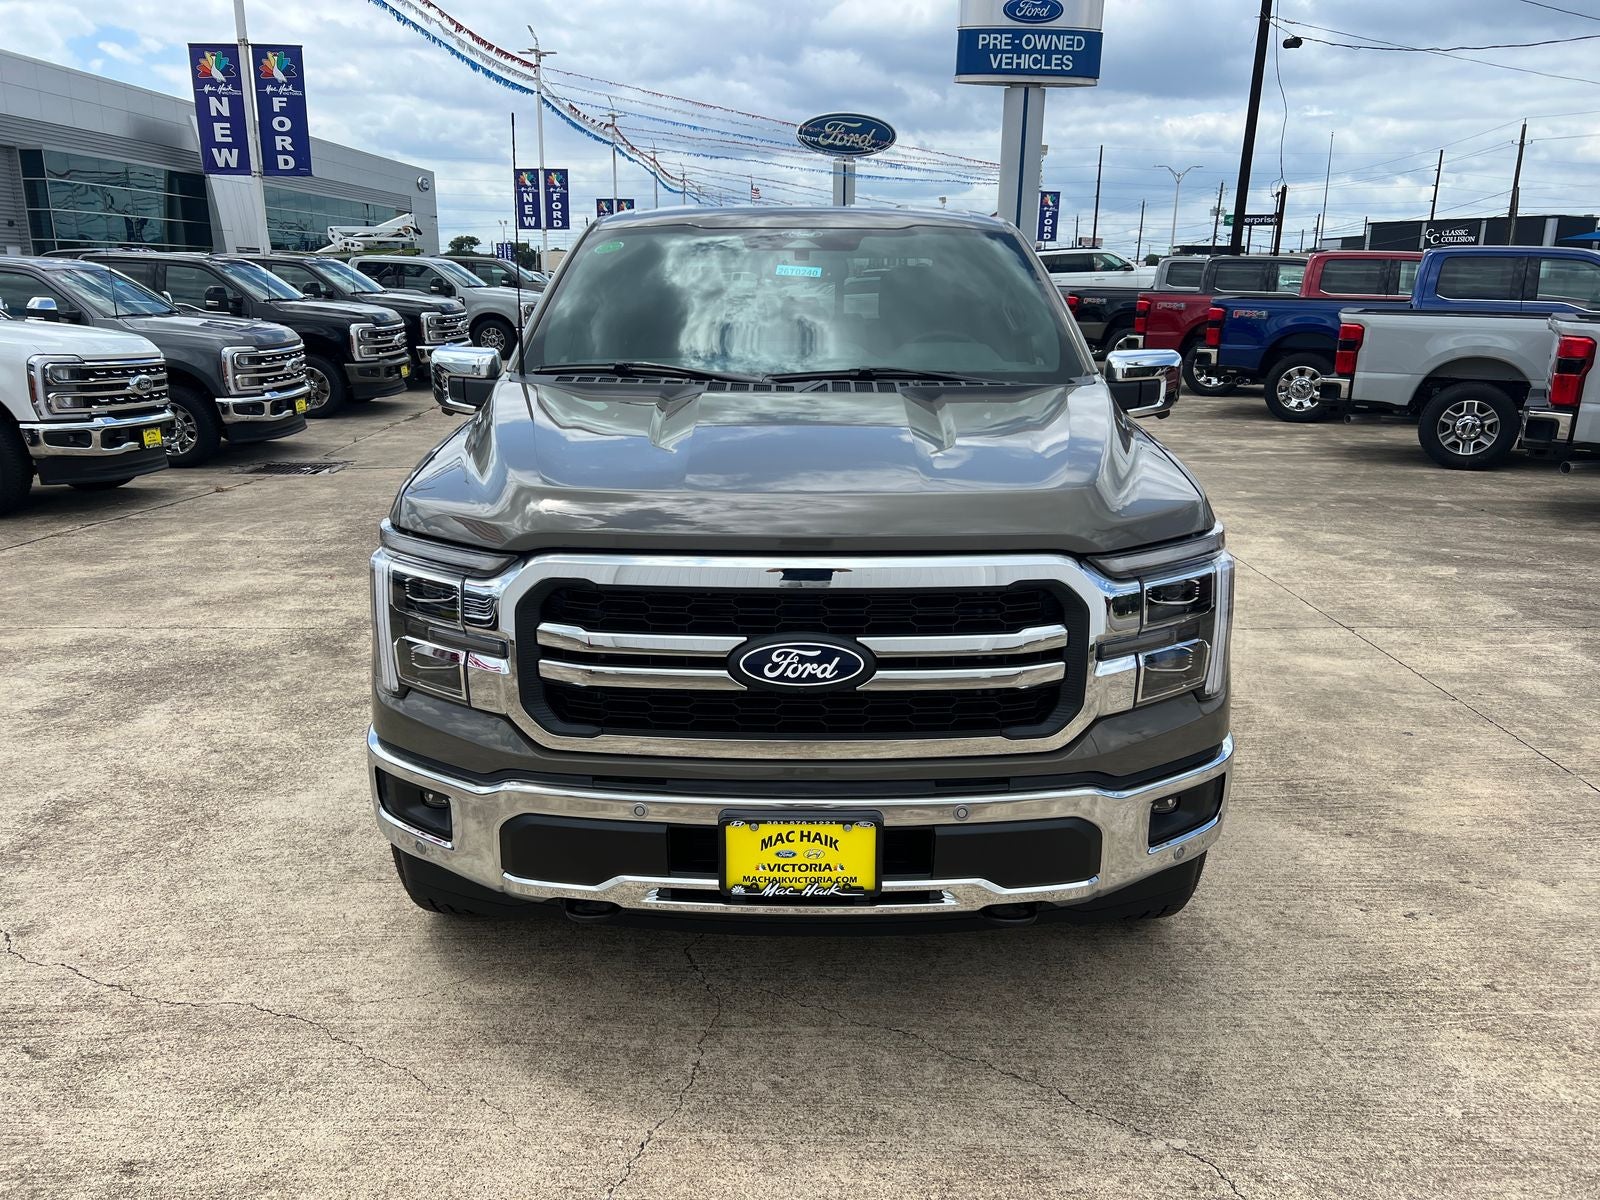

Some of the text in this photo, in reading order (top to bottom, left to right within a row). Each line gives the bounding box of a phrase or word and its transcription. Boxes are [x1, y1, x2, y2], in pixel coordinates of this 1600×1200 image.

[1015, 0, 1050, 17] Ford
[978, 34, 1085, 51] PRE-OWNED
[990, 53, 1073, 70] VEHICLES
[208, 96, 239, 168] NEW
[271, 97, 295, 170] FORD
[818, 120, 877, 147] Ford
[523, 192, 536, 226] NEW
[552, 193, 562, 227] FORD
[1043, 211, 1053, 240] FORD
[1233, 310, 1268, 319] FX4
[763, 648, 841, 679] Ford
[760, 830, 839, 851] MAC HAIK
[767, 863, 833, 873] VICTORIA
[742, 875, 858, 884] MACHAIKVICTORIA.COM
[760, 882, 842, 897] Mac Haik
